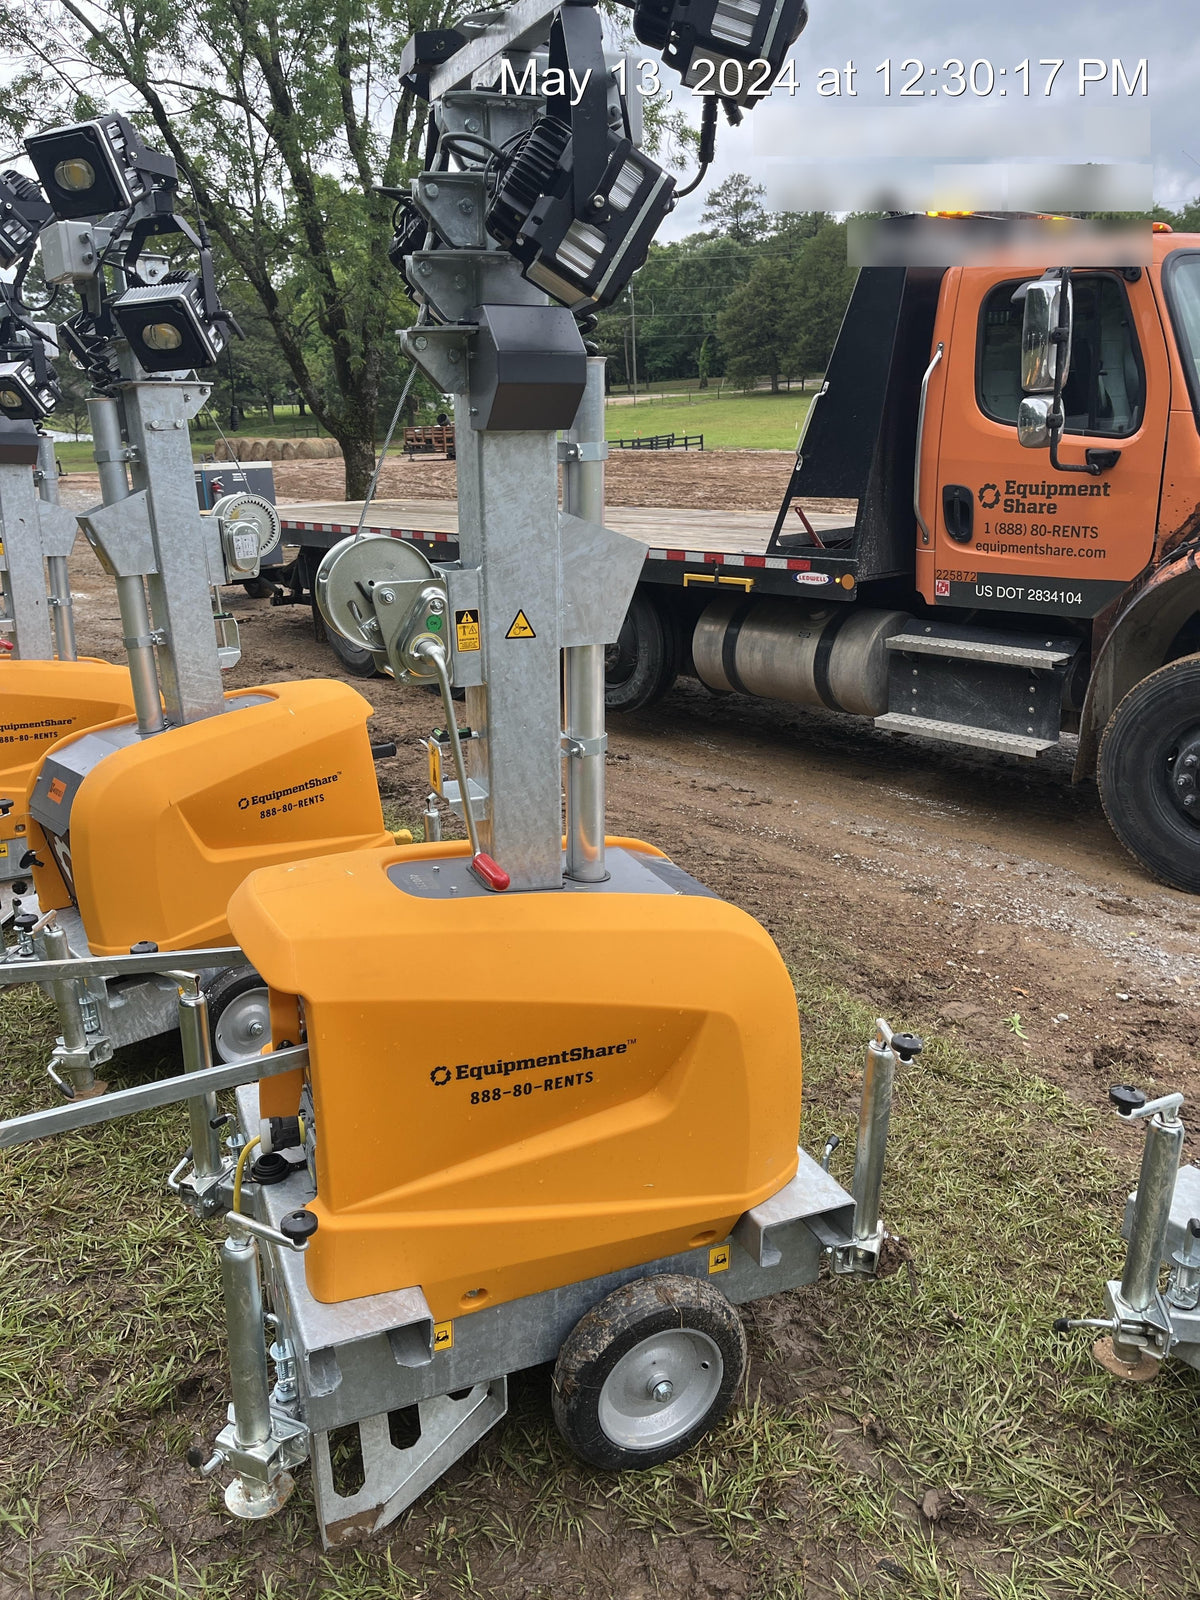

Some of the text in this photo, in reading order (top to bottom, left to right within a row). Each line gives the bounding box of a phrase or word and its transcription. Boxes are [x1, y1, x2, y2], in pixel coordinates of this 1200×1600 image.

[1004, 480, 1111, 499] Equipment
[1003, 498, 1058, 515] Share
[984, 522, 1099, 539] 1 (888) 80-RENTS
[975, 541, 1107, 559] equipmentshare.com
[936, 570, 977, 582] 225872
[975, 584, 1082, 604] US DOT 2834104
[259, 793, 325, 819] 888-80-RENTS
[470, 1071, 594, 1105] 888-80-RENTS
